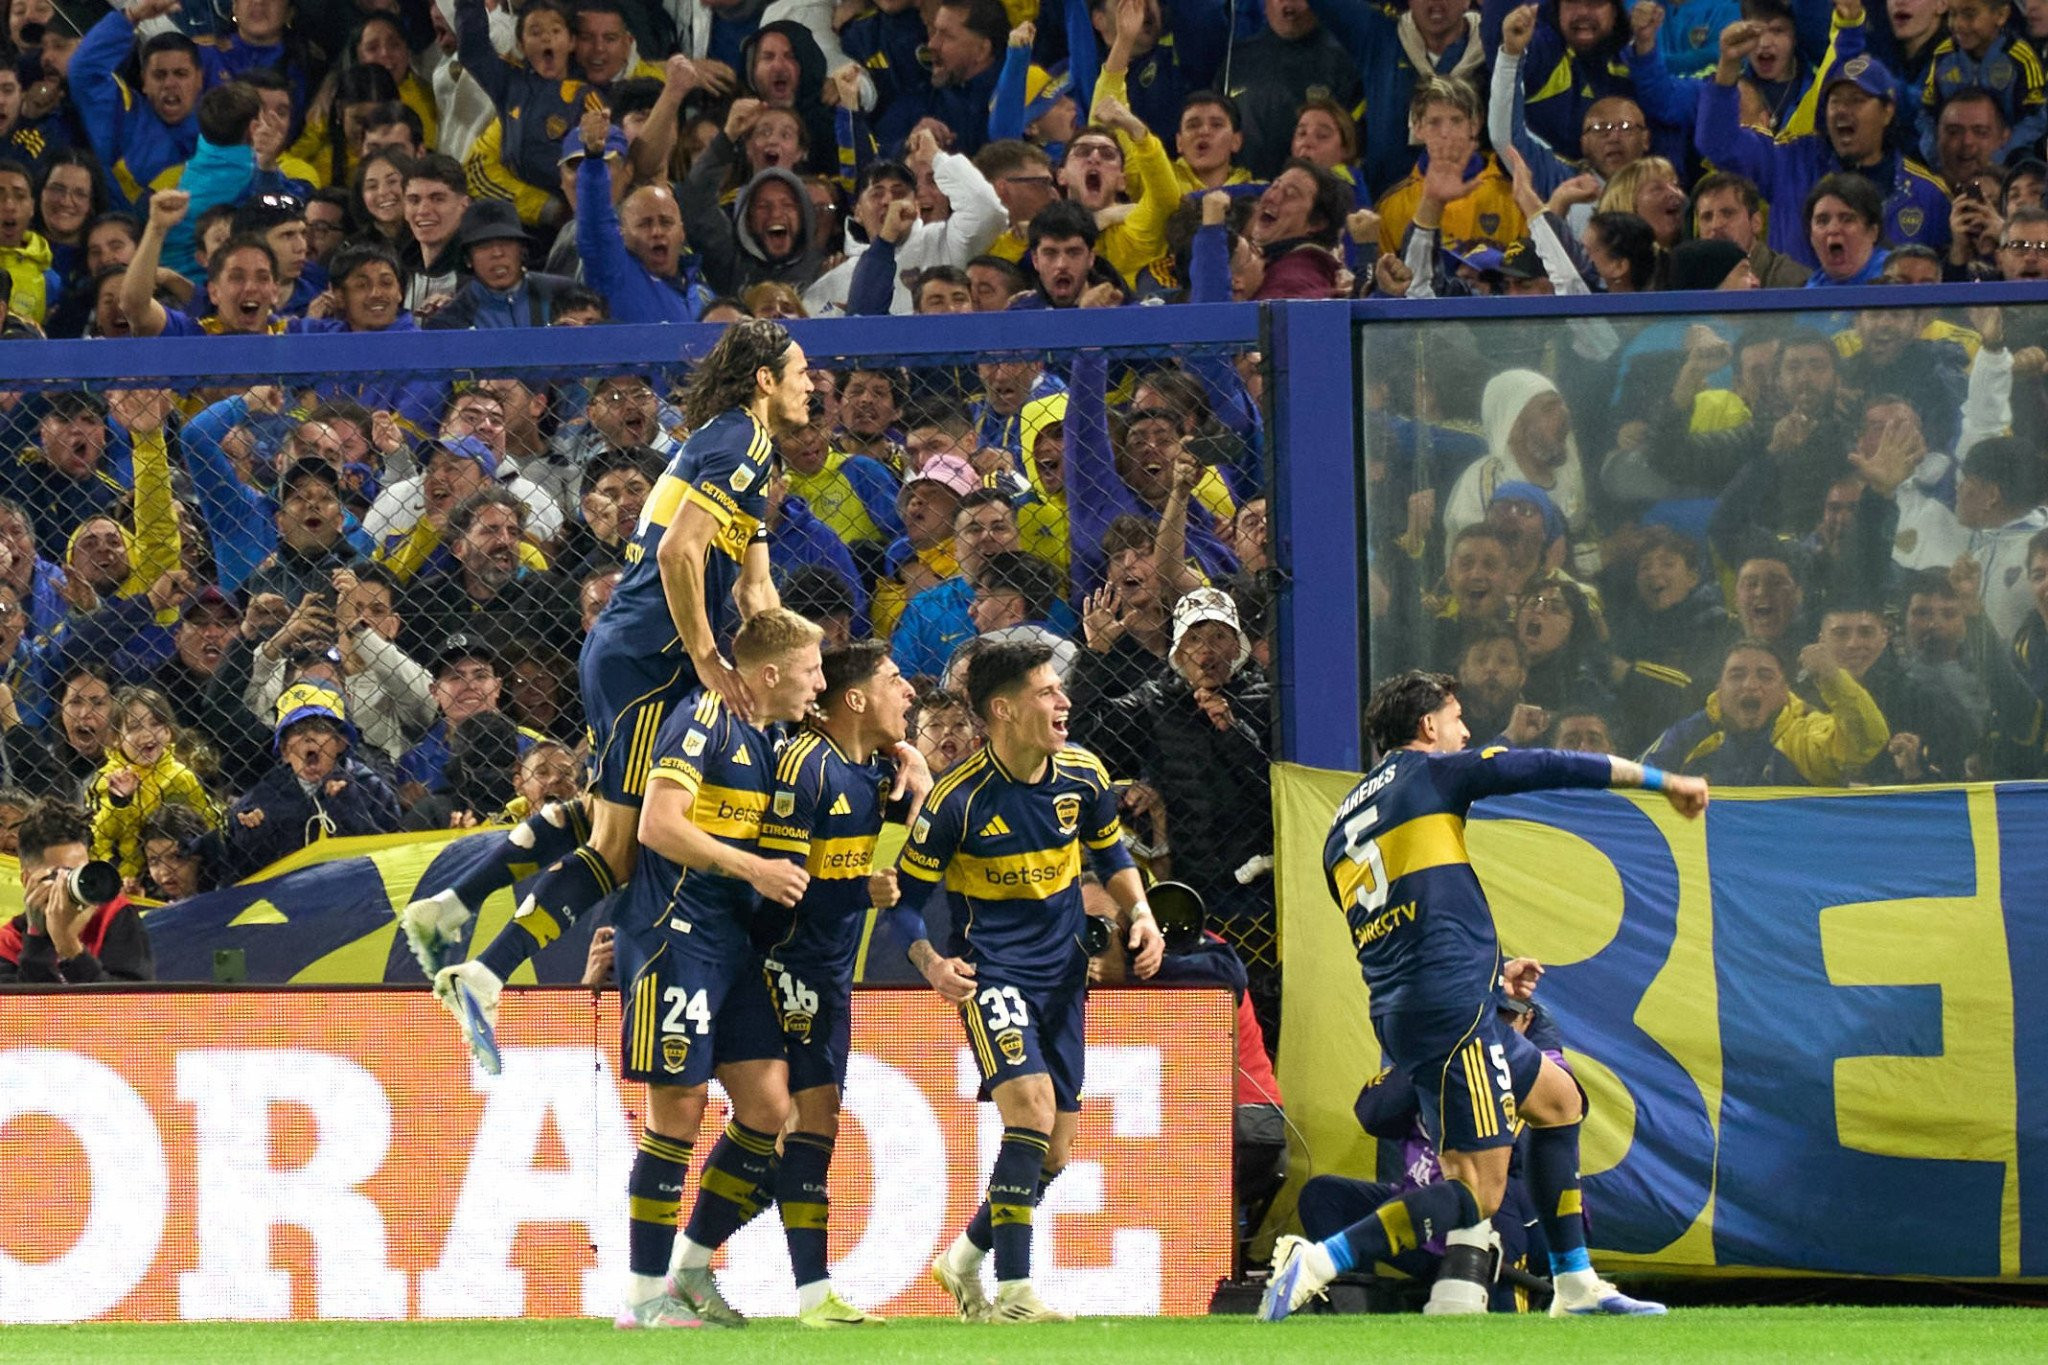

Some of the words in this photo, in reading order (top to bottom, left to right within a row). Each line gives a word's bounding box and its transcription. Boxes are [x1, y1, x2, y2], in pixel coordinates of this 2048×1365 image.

[762, 822, 810, 841] ETROGAR
[1344, 804, 1390, 913] 5
[662, 986, 711, 1034] 24
[778, 972, 819, 1015] 16
[979, 985, 1029, 1031] 33
[1377, 783, 2048, 1280] BE
[1489, 1043, 1512, 1091] 5
